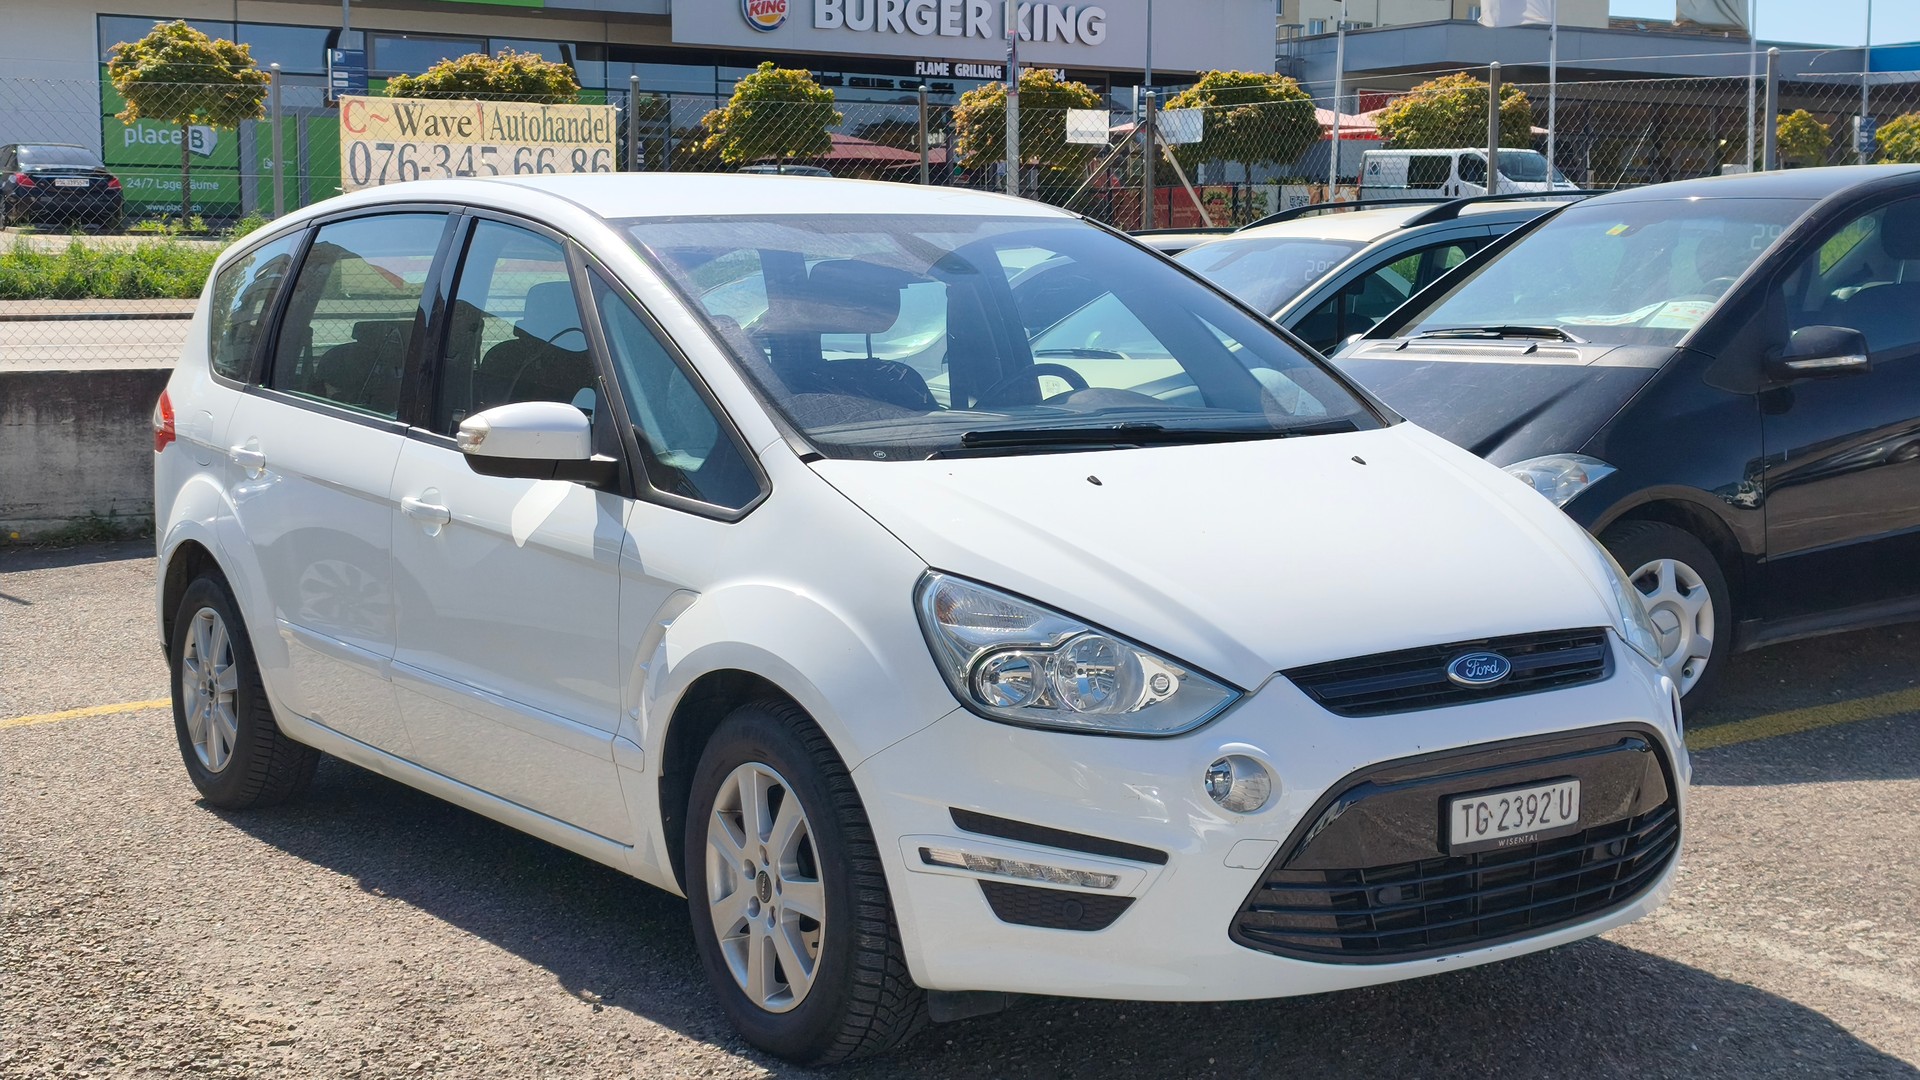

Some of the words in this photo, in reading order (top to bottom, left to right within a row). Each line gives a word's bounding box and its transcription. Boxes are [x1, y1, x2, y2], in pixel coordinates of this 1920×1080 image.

[749, 0, 786, 16] KING
[814, 0, 993, 39] BURGER
[1003, 2, 1107, 46] KING
[334, 51, 343, 62] P
[915, 61, 950, 77] FLAME
[955, 63, 1002, 79] GRILLING
[490, 106, 612, 143] Autohandel
[349, 141, 499, 186] 076-345
[126, 178, 154, 189] 24/7
[156, 178, 219, 191] Lageäume
[1466, 657, 1500, 677] Ford
[1462, 801, 1489, 837] TG
